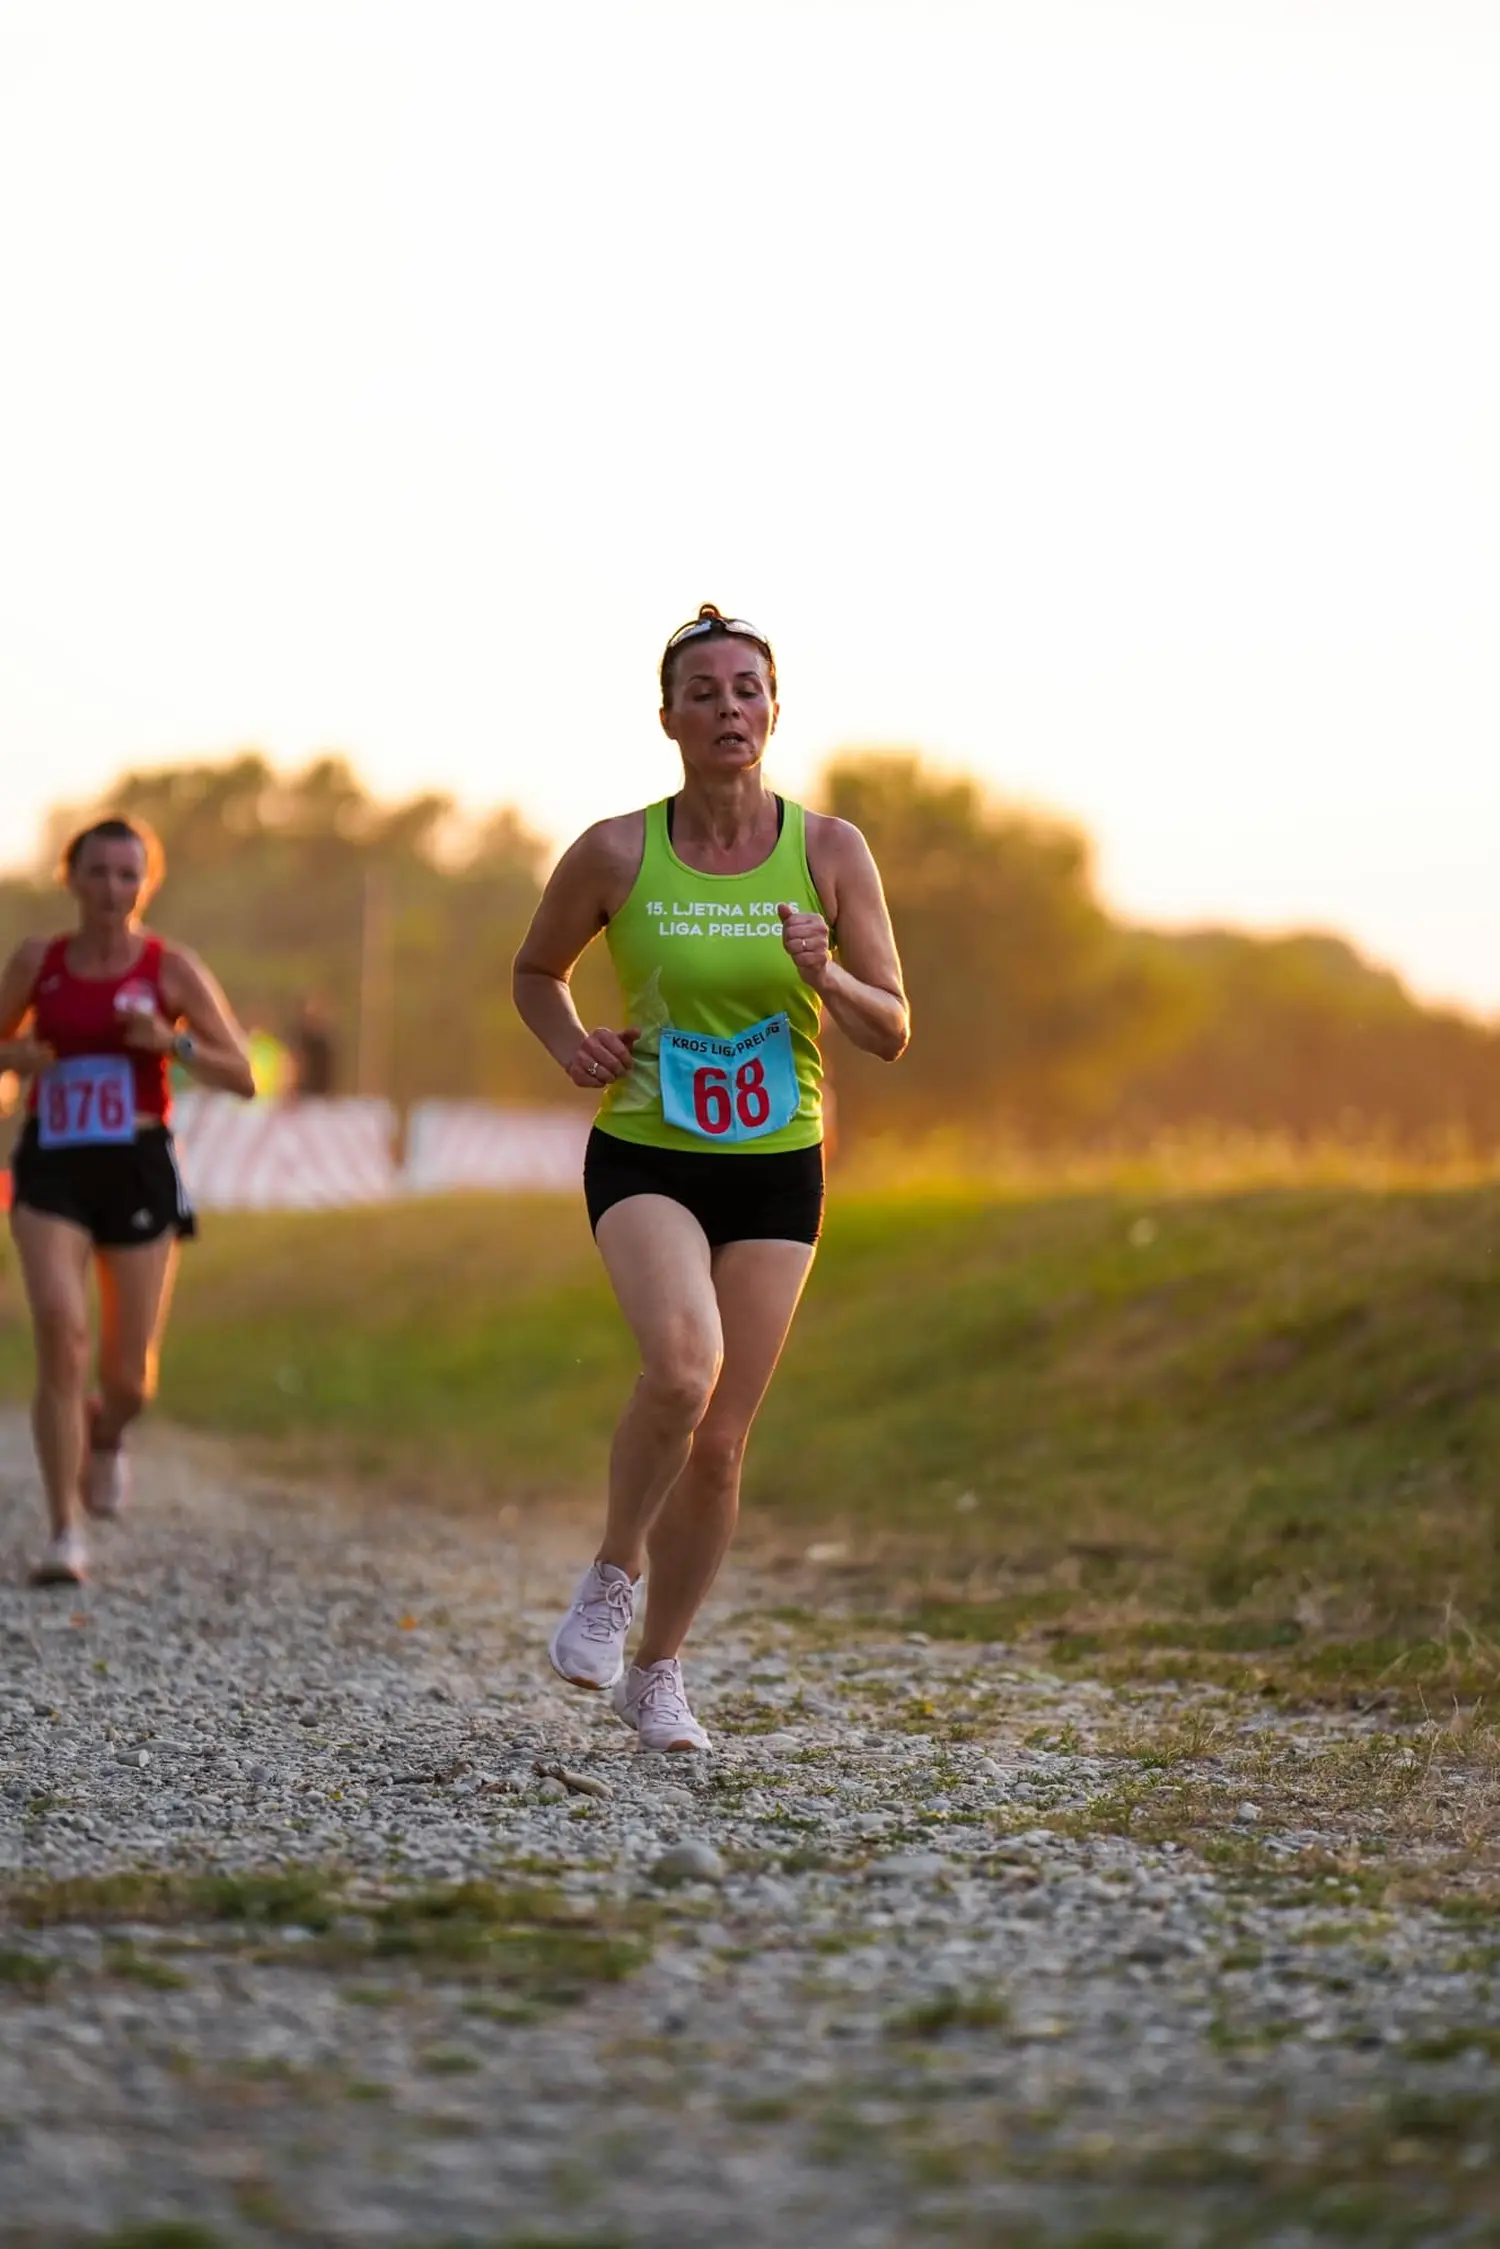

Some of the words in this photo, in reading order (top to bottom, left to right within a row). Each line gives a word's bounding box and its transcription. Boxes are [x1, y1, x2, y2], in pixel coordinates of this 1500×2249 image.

[645, 901, 667, 916] 15.
[672, 902, 744, 916] LJETNA
[749, 902, 800, 916] KRS
[659, 922, 703, 936] LIGA
[708, 922, 783, 936] PRELOG
[671, 1036, 708, 1053] KROS
[693, 1057, 770, 1135] 68
